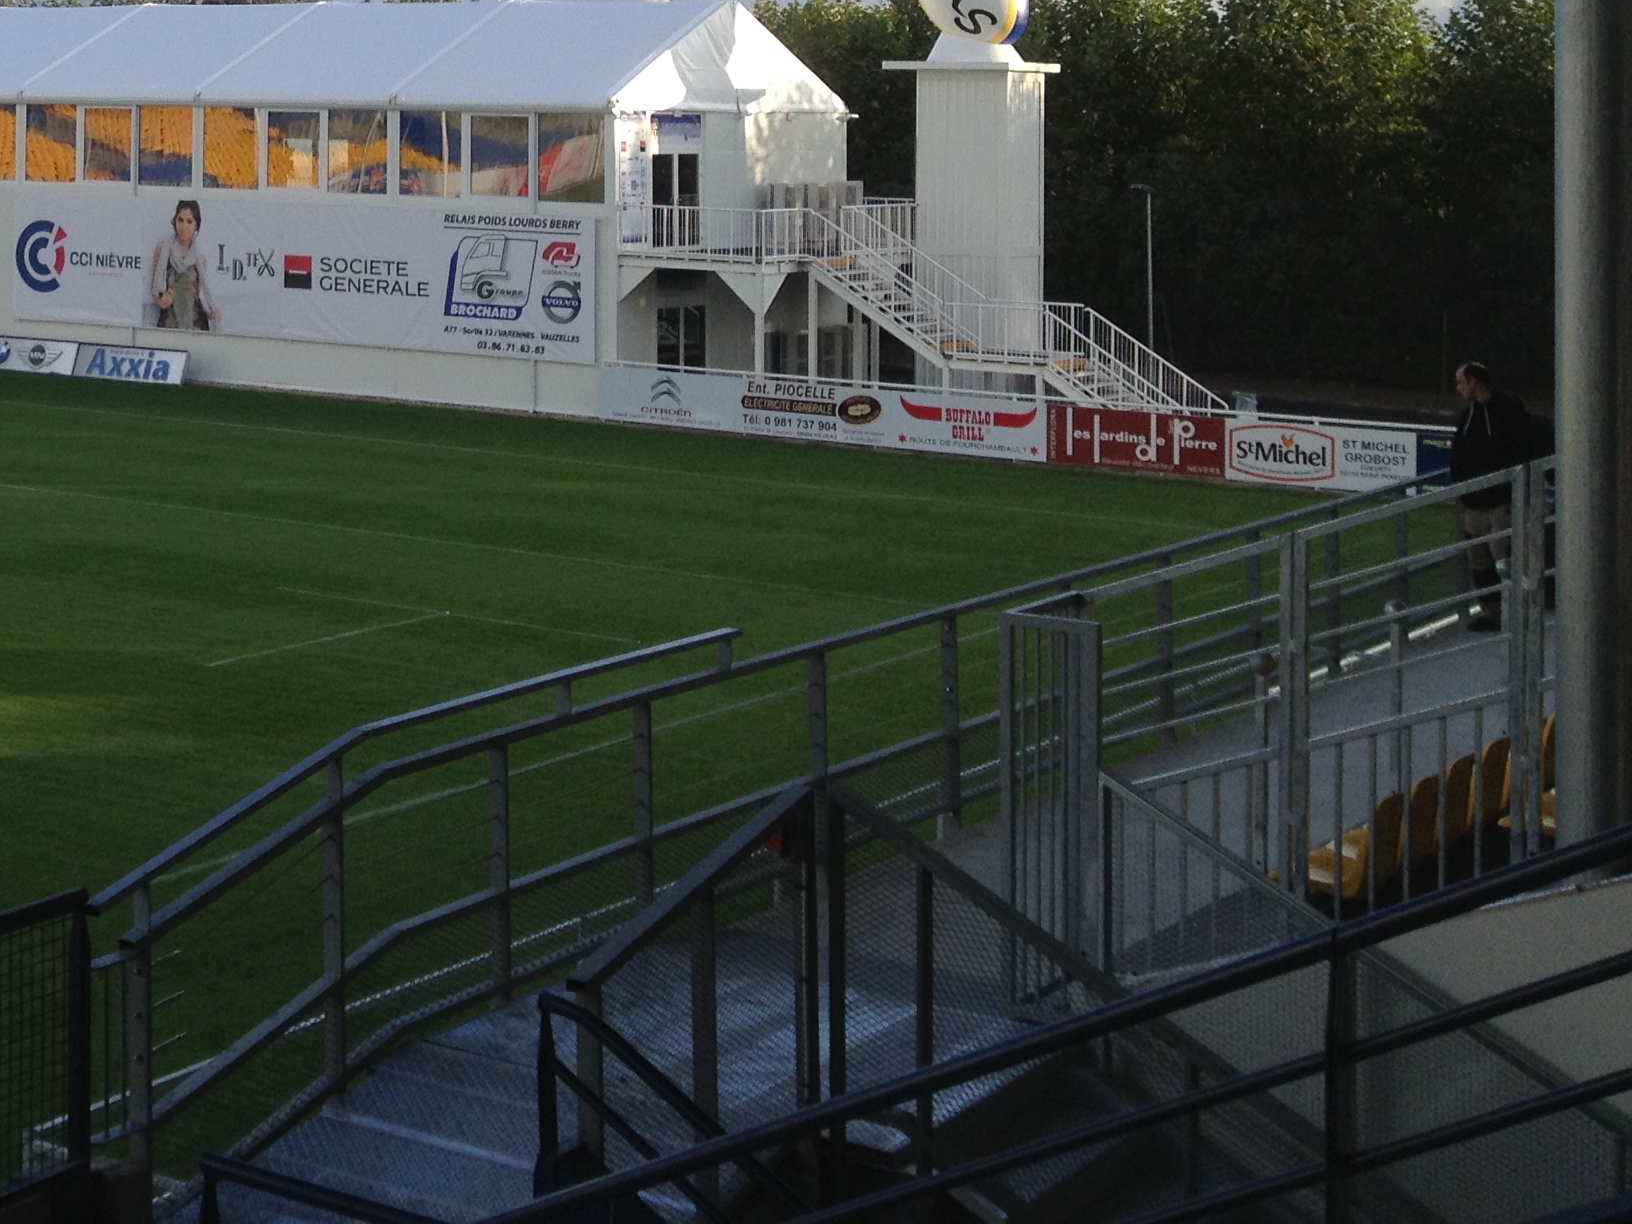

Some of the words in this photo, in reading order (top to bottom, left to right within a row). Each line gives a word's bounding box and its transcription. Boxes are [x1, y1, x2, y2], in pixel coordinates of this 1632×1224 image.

[444, 214, 475, 225] RELAIS
[477, 215, 507, 226] POIDS
[508, 217, 548, 229] LOURDS
[549, 219, 581, 230] BERRY
[70, 251, 92, 267] CCI
[95, 252, 141, 270] NIÈVRE
[320, 257, 409, 277] SOCIETE
[319, 276, 430, 298] GENERALE
[476, 281, 523, 300] Groupe
[545, 297, 579, 307] VOLVO
[450, 304, 517, 318] BROCHARD
[86, 348, 170, 381] Axxia
[747, 380, 769, 395] Ent.
[775, 382, 836, 400] PIOCELLE
[764, 416, 772, 426] 0
[774, 416, 793, 428] 981
[796, 418, 815, 430] 737
[818, 421, 837, 432] 904
[945, 407, 991, 425] BUFFALO
[952, 425, 984, 442] GRILL
[909, 436, 937, 446] ROUTE
[939, 439, 952, 448] DE
[1342, 439, 1359, 450] ST
[1361, 441, 1409, 454] MICHEL
[1344, 453, 1408, 467] GROBOST
[1186, 465, 1221, 475] NEVERS
